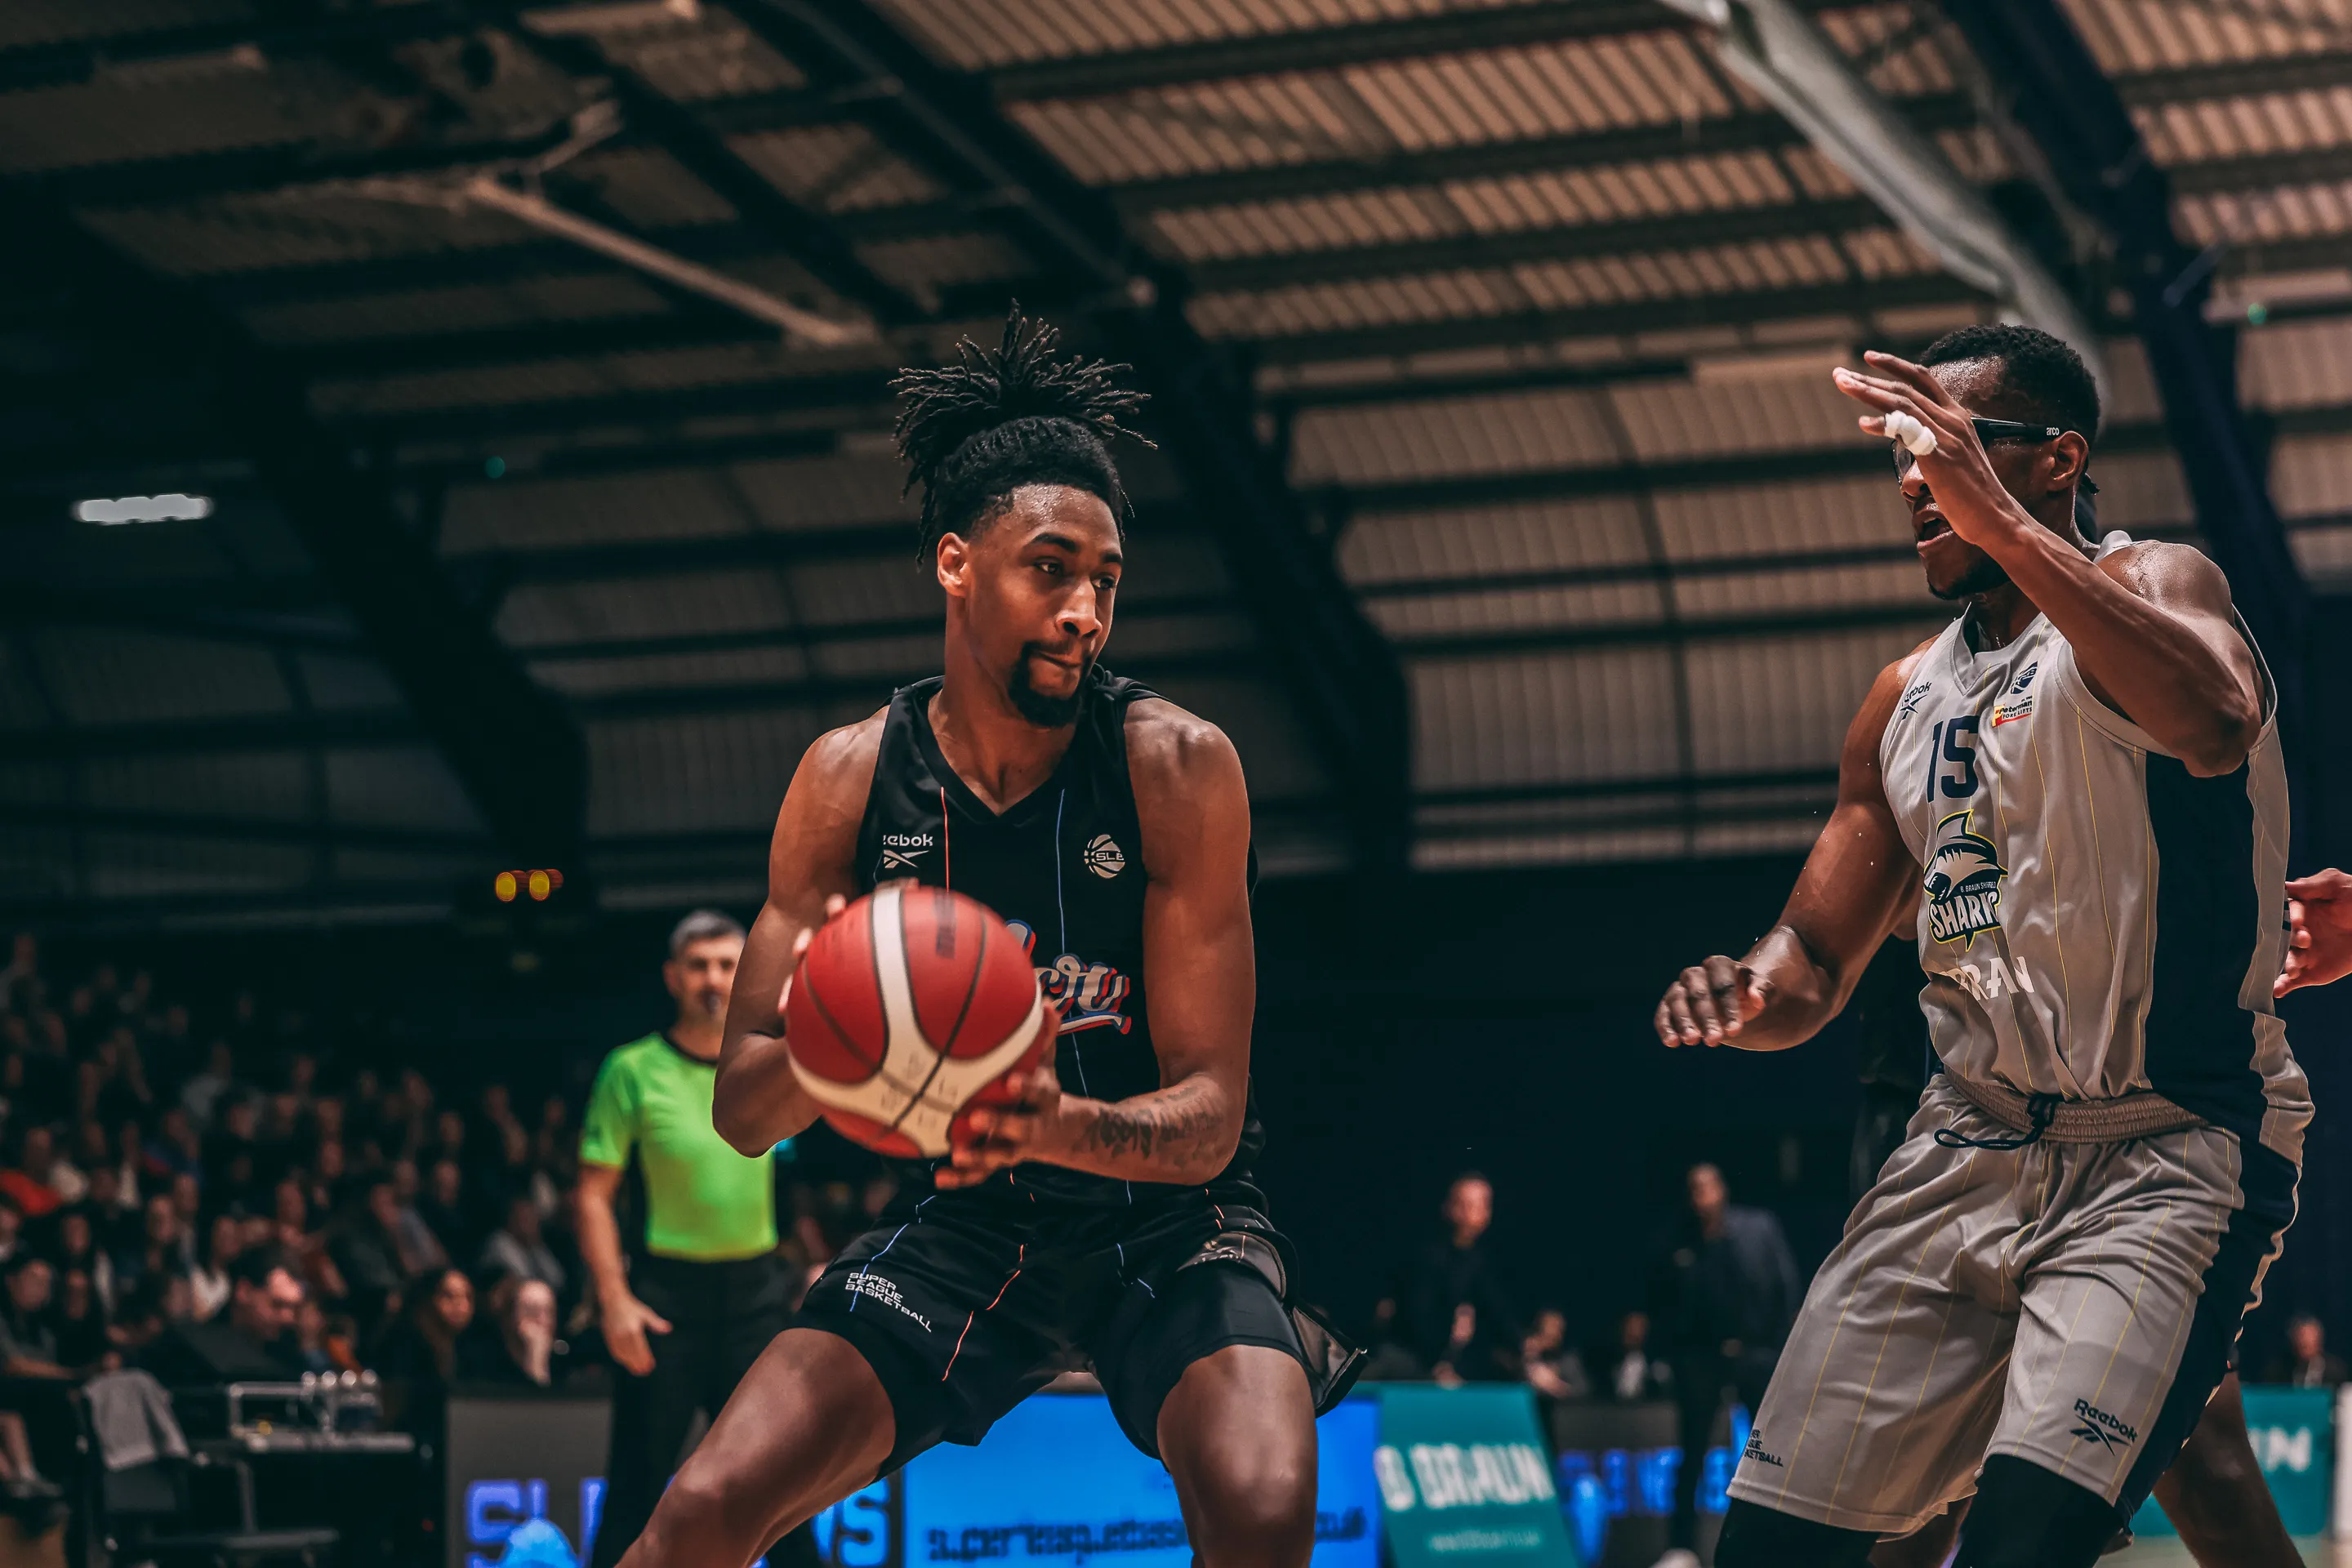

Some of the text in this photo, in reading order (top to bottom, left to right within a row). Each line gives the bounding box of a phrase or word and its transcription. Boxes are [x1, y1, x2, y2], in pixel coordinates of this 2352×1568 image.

[1927, 715, 1980, 803] 15
[883, 834, 933, 846] ebok
[1096, 852, 1125, 862] SLB
[847, 1278, 903, 1303] LEAGUE
[849, 1272, 897, 1290] SUPER
[845, 1284, 932, 1333] BASKETBALL
[2074, 1398, 2138, 1443] Reebok
